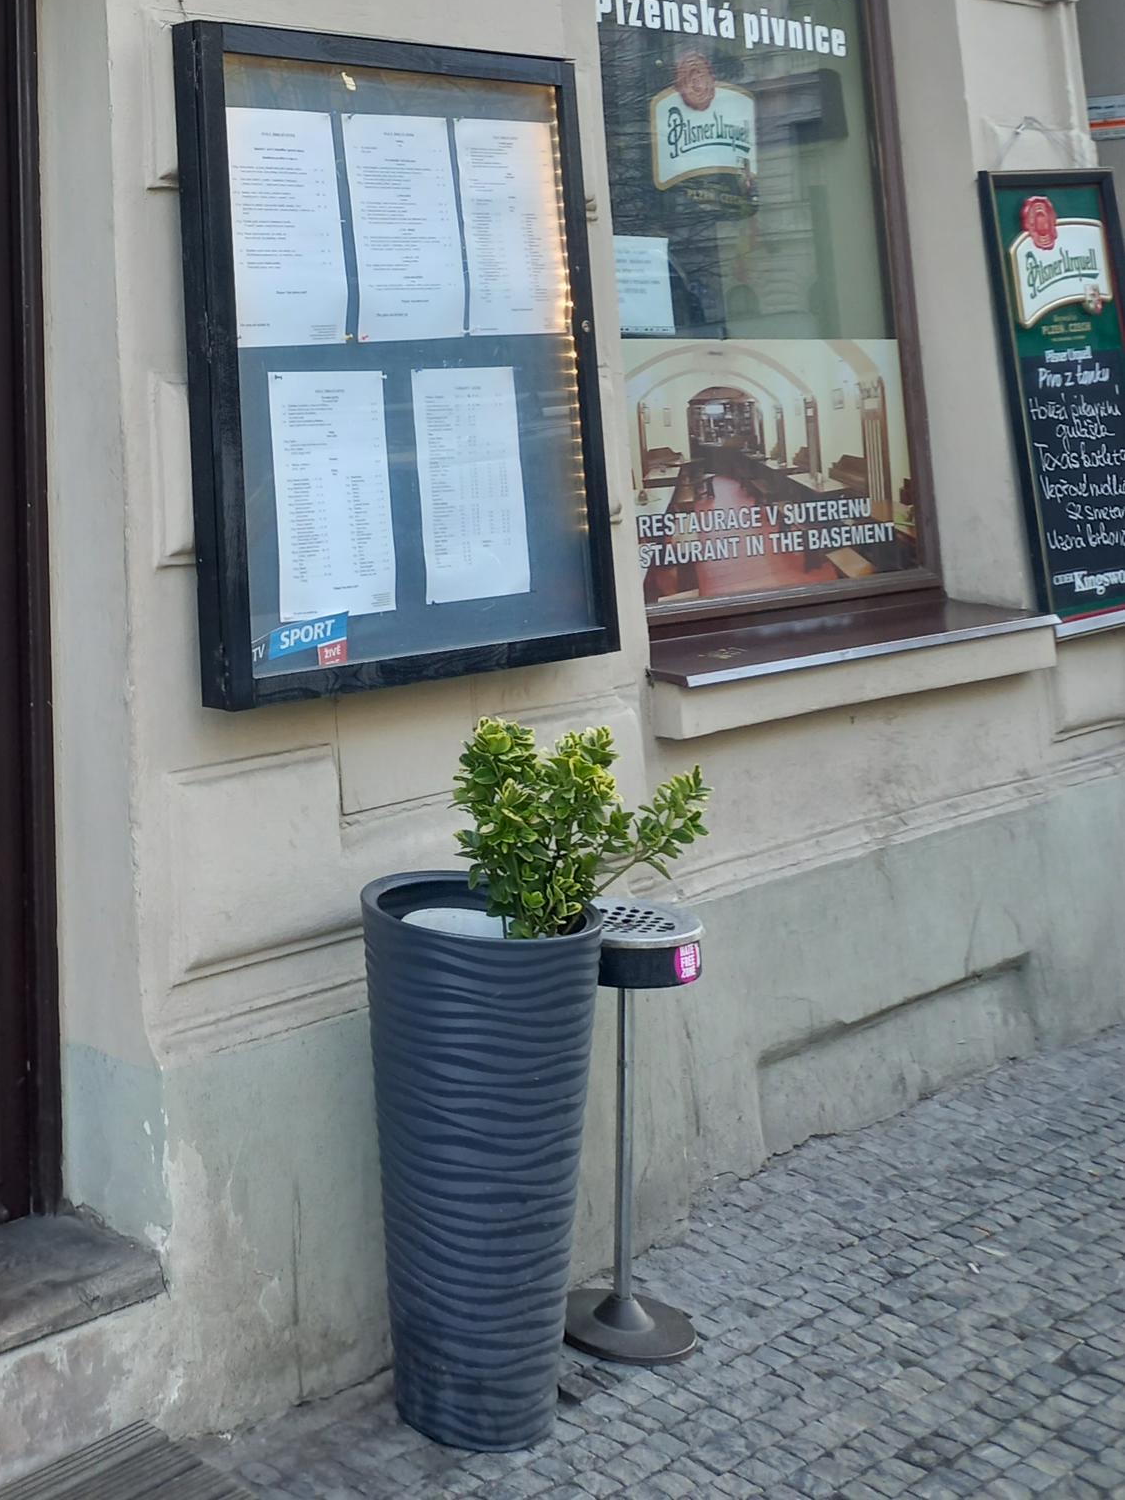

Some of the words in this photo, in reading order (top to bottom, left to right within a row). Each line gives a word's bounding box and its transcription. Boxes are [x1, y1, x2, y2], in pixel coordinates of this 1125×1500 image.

[743, 7, 847, 57] pivnice
[667, 106, 715, 159] Pilsner
[1025, 251, 1063, 299] Pilsner
[1059, 247, 1098, 281] Urquell
[1044, 349, 1068, 363] Pilsner
[1066, 345, 1093, 363] Urquell
[1033, 442, 1080, 473] Texas
[638, 506, 763, 539] RESTAURACE
[766, 504, 779, 526] V
[783, 494, 872, 526] SUTERÉNU
[746, 534, 765, 558] IN
[770, 531, 805, 555] THE
[808, 522, 896, 550] BASEMENT
[251, 643, 266, 662] TV
[279, 619, 336, 650] SPORT
